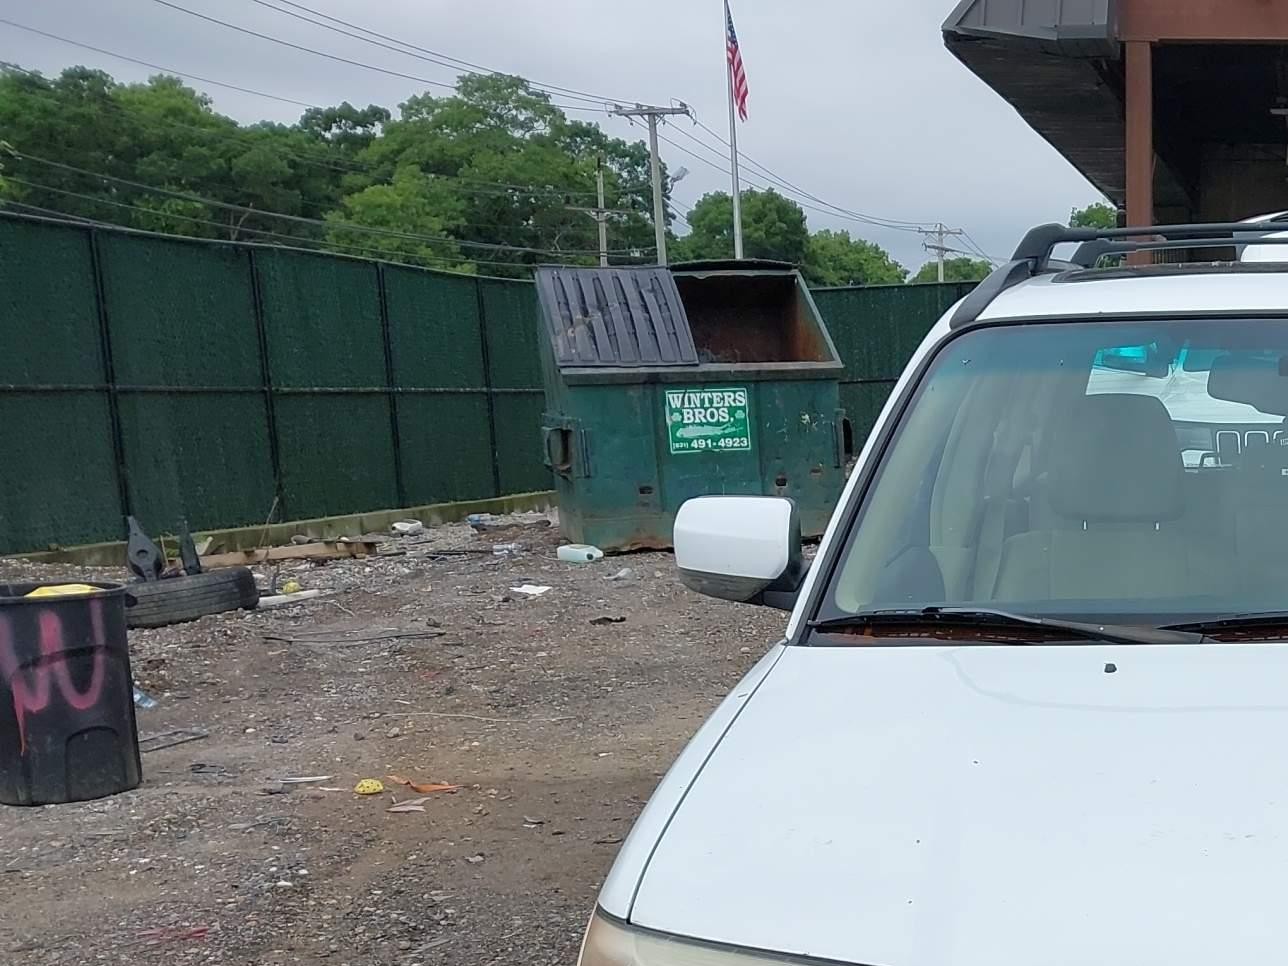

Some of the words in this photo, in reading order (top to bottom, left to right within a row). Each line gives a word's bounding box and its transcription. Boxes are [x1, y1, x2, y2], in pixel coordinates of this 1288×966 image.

[668, 391, 746, 408] WINTERS
[682, 407, 734, 423] BROS.
[690, 437, 748, 450] 491-4923
